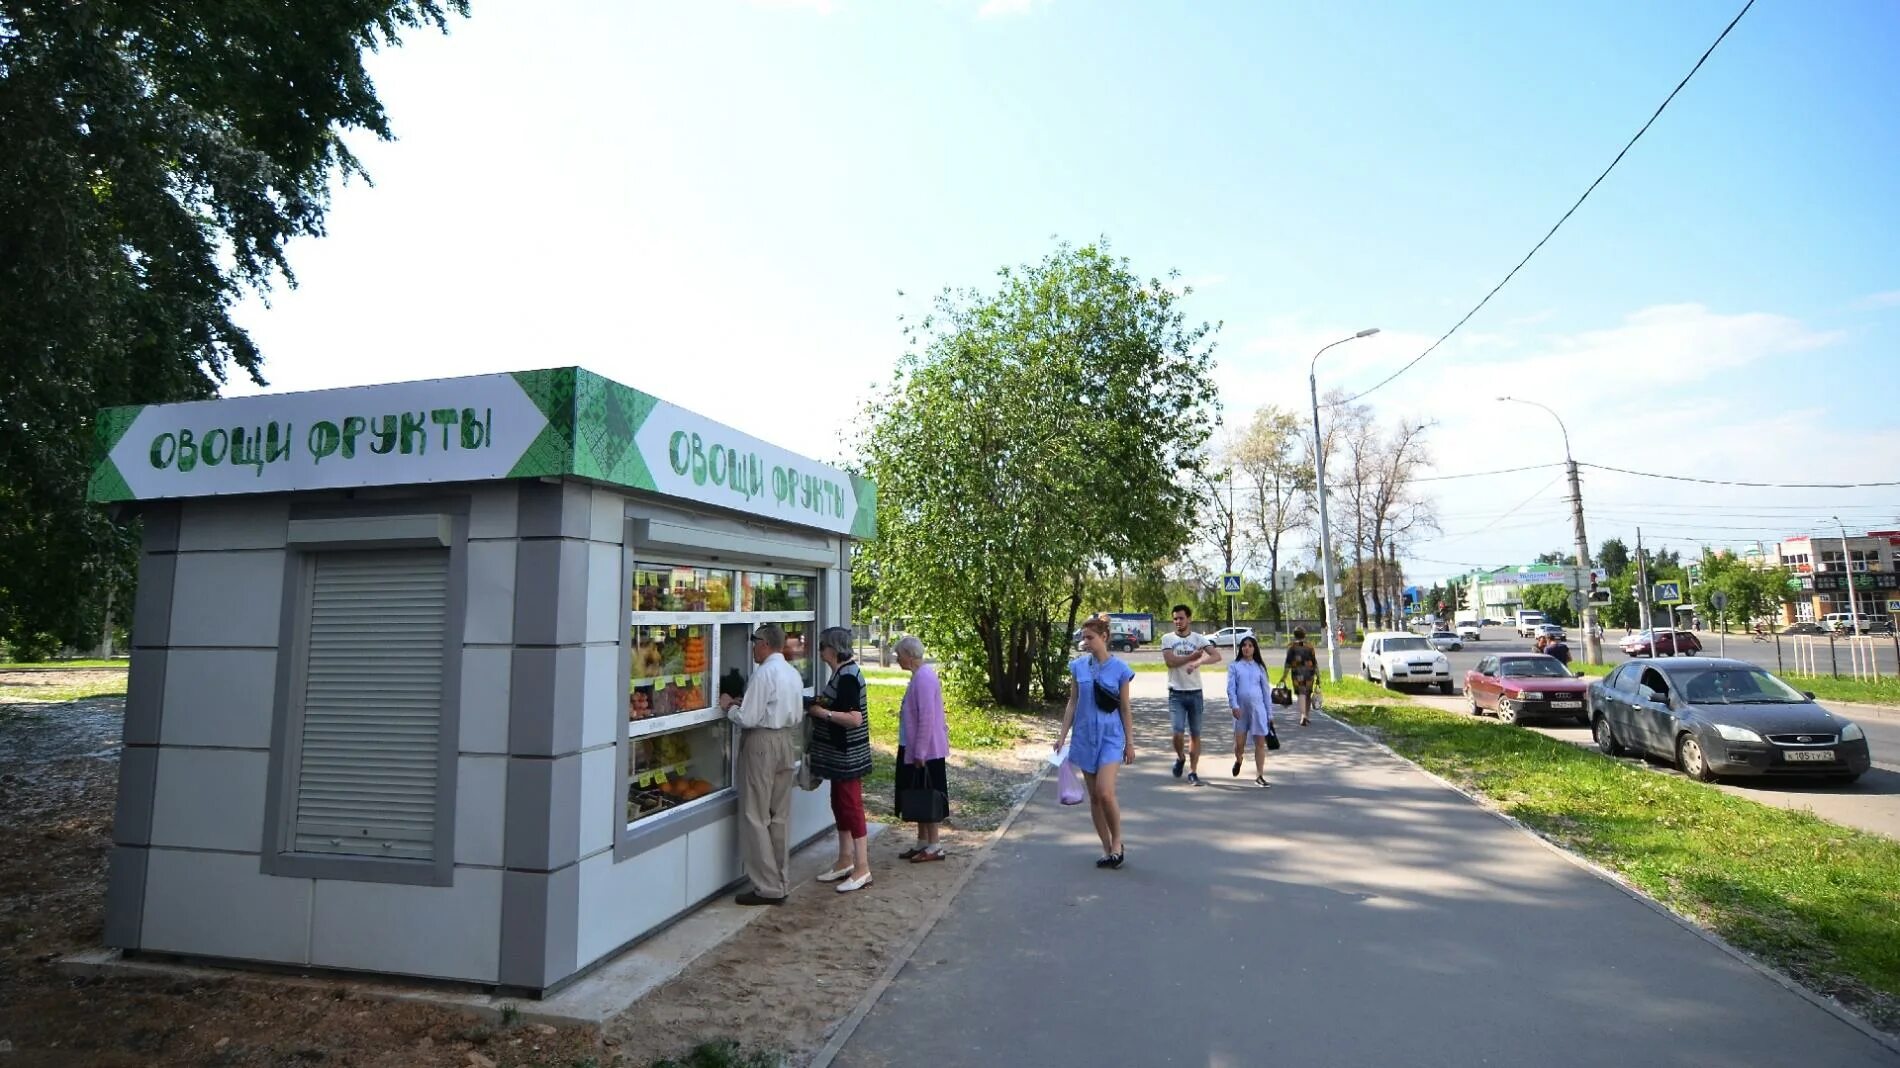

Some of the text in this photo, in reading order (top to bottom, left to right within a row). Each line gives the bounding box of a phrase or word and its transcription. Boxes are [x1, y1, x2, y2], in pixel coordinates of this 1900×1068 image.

[149, 407, 492, 477] ОВОЩИ ФРУКТЫ
[669, 430, 846, 520] ОВОЩИ ФРУКТЫ
